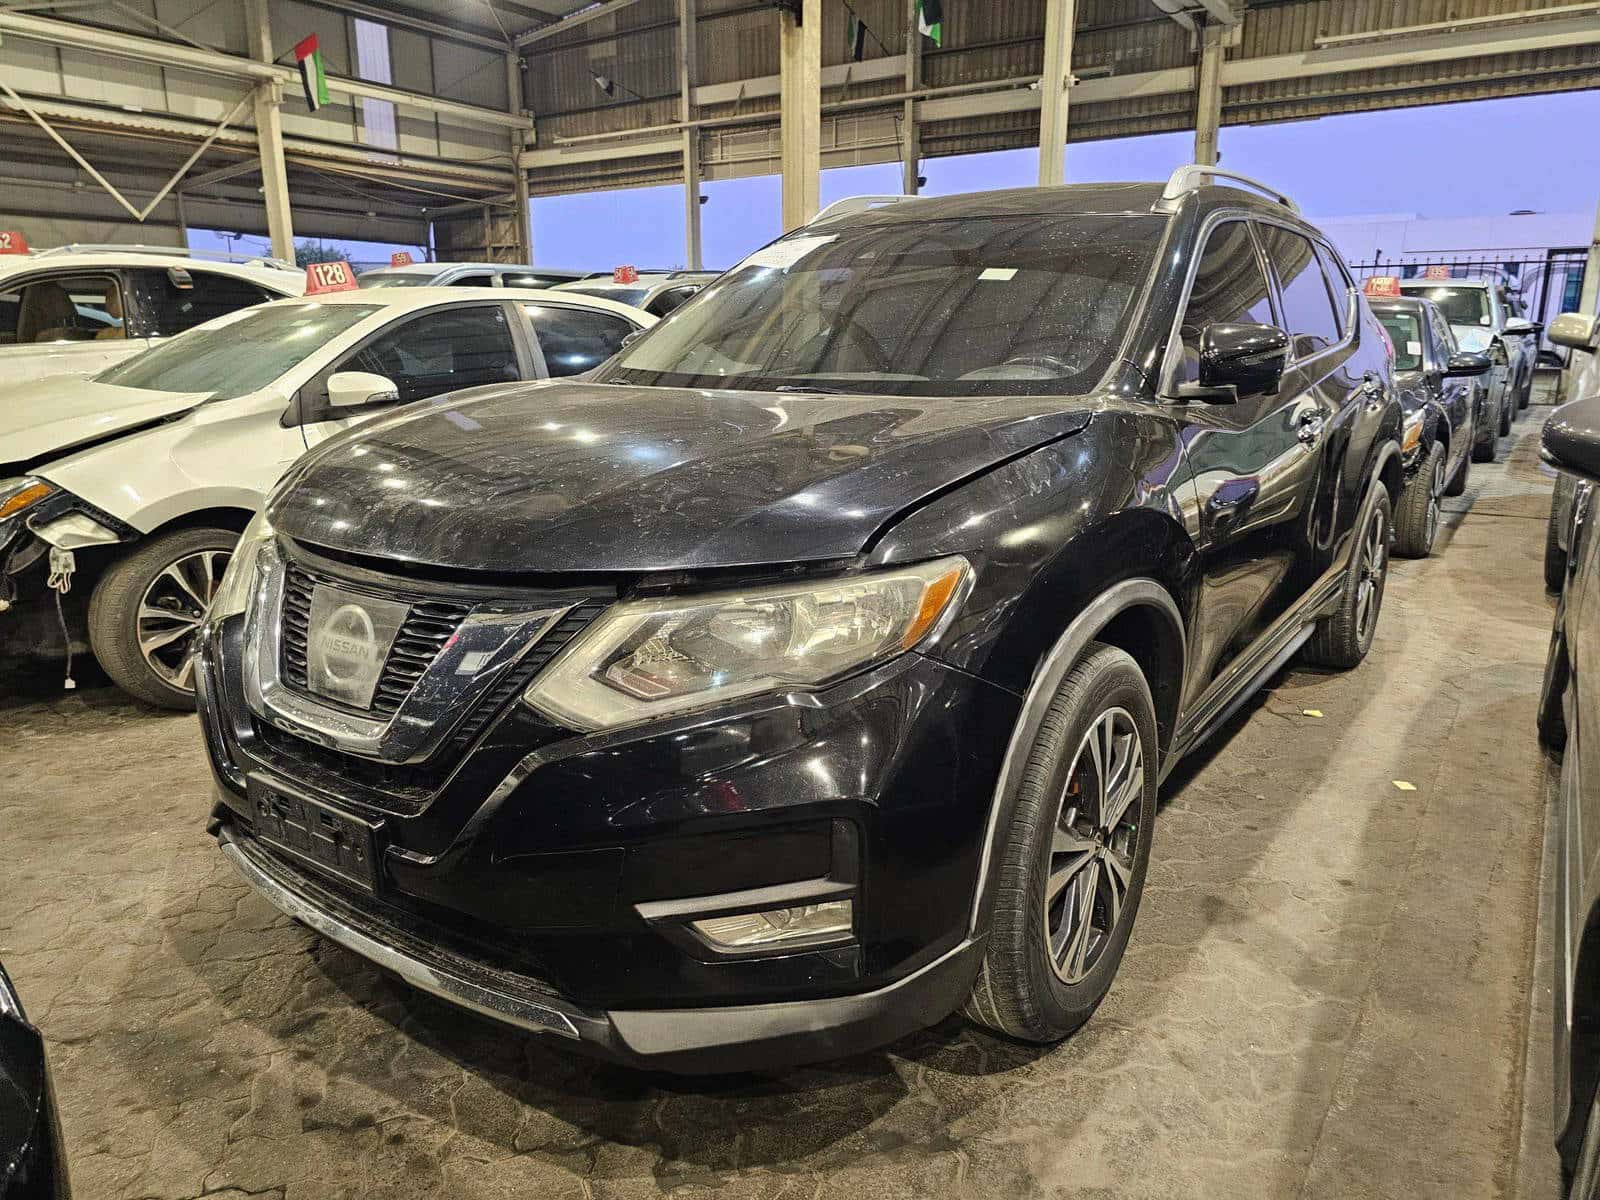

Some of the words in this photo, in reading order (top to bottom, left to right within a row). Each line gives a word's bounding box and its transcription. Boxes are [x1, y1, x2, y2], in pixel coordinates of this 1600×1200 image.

[0, 232, 12, 249] 2
[315, 263, 346, 286] 128
[321, 635, 369, 657] NISSAN
